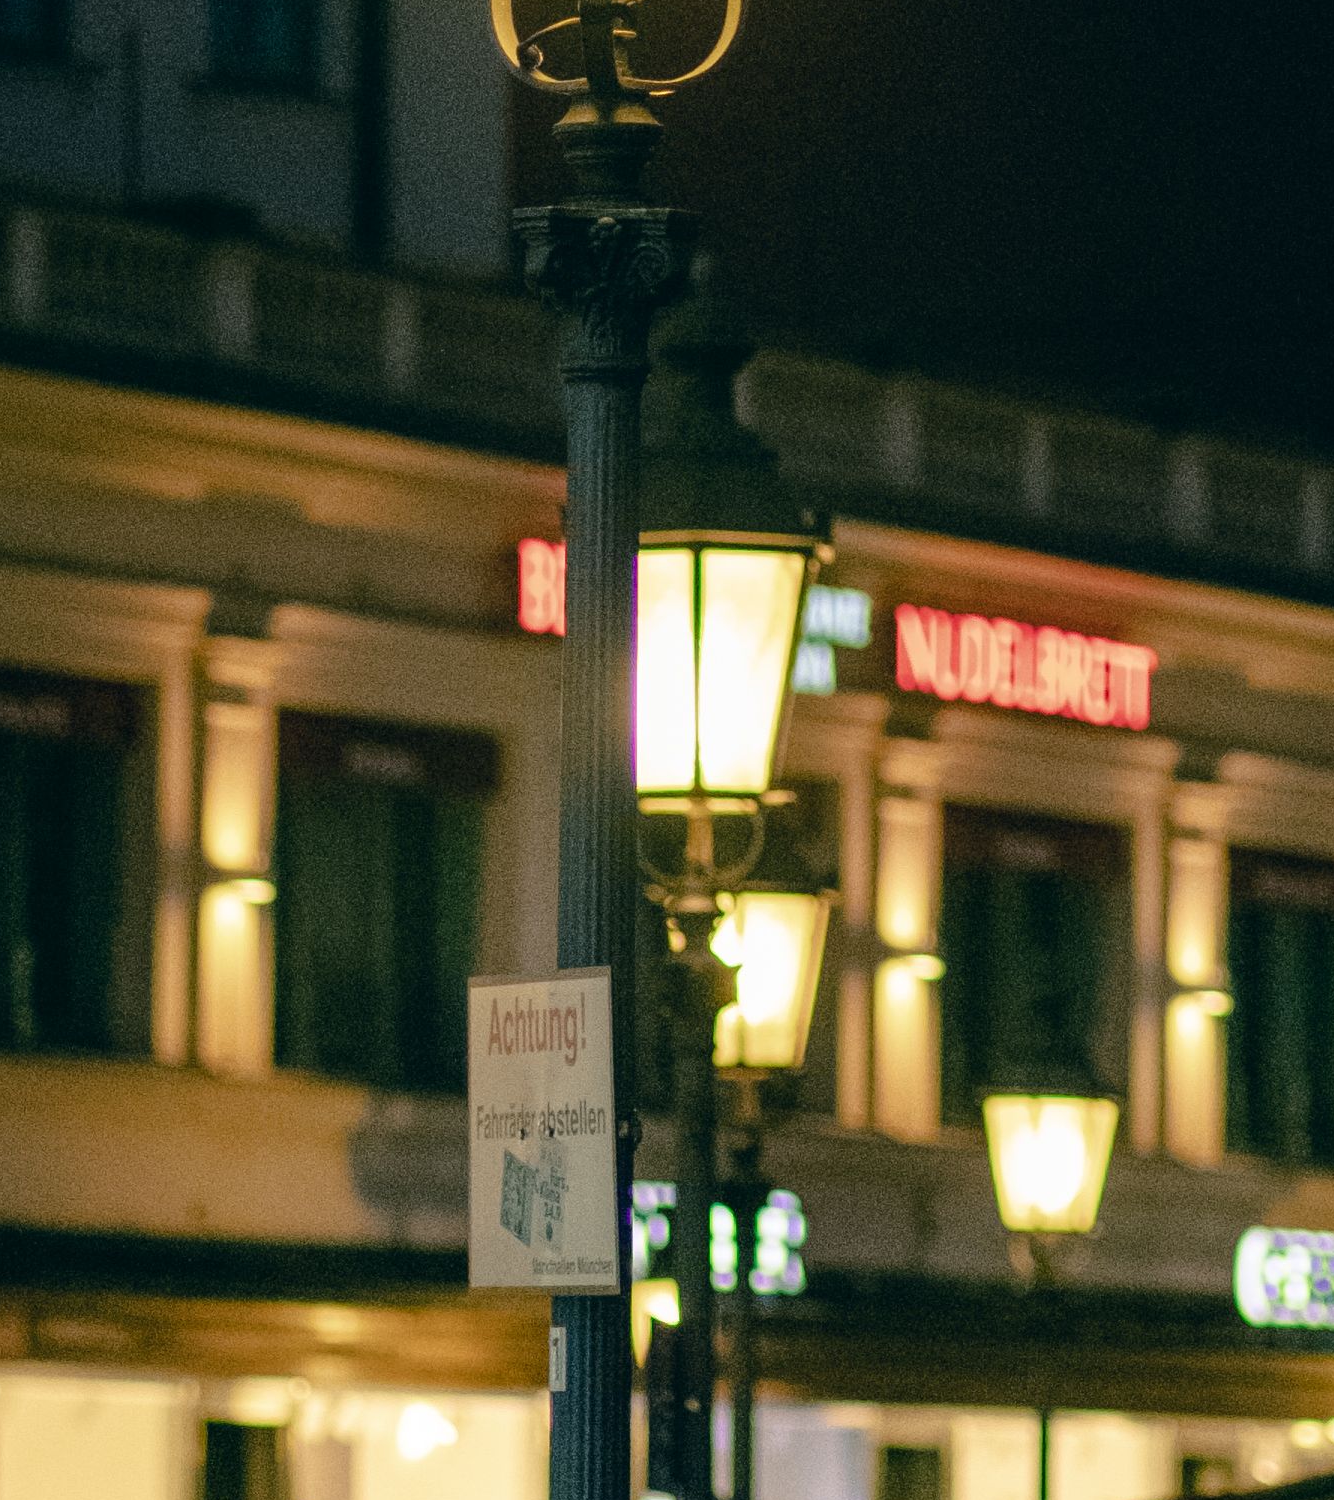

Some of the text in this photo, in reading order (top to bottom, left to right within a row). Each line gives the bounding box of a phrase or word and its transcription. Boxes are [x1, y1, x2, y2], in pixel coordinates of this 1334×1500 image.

[896, 603, 1159, 732] NUDELBRETT
[488, 992, 586, 1066] Achtung!
[476, 1101, 607, 1142] Fahrräder abstellen
